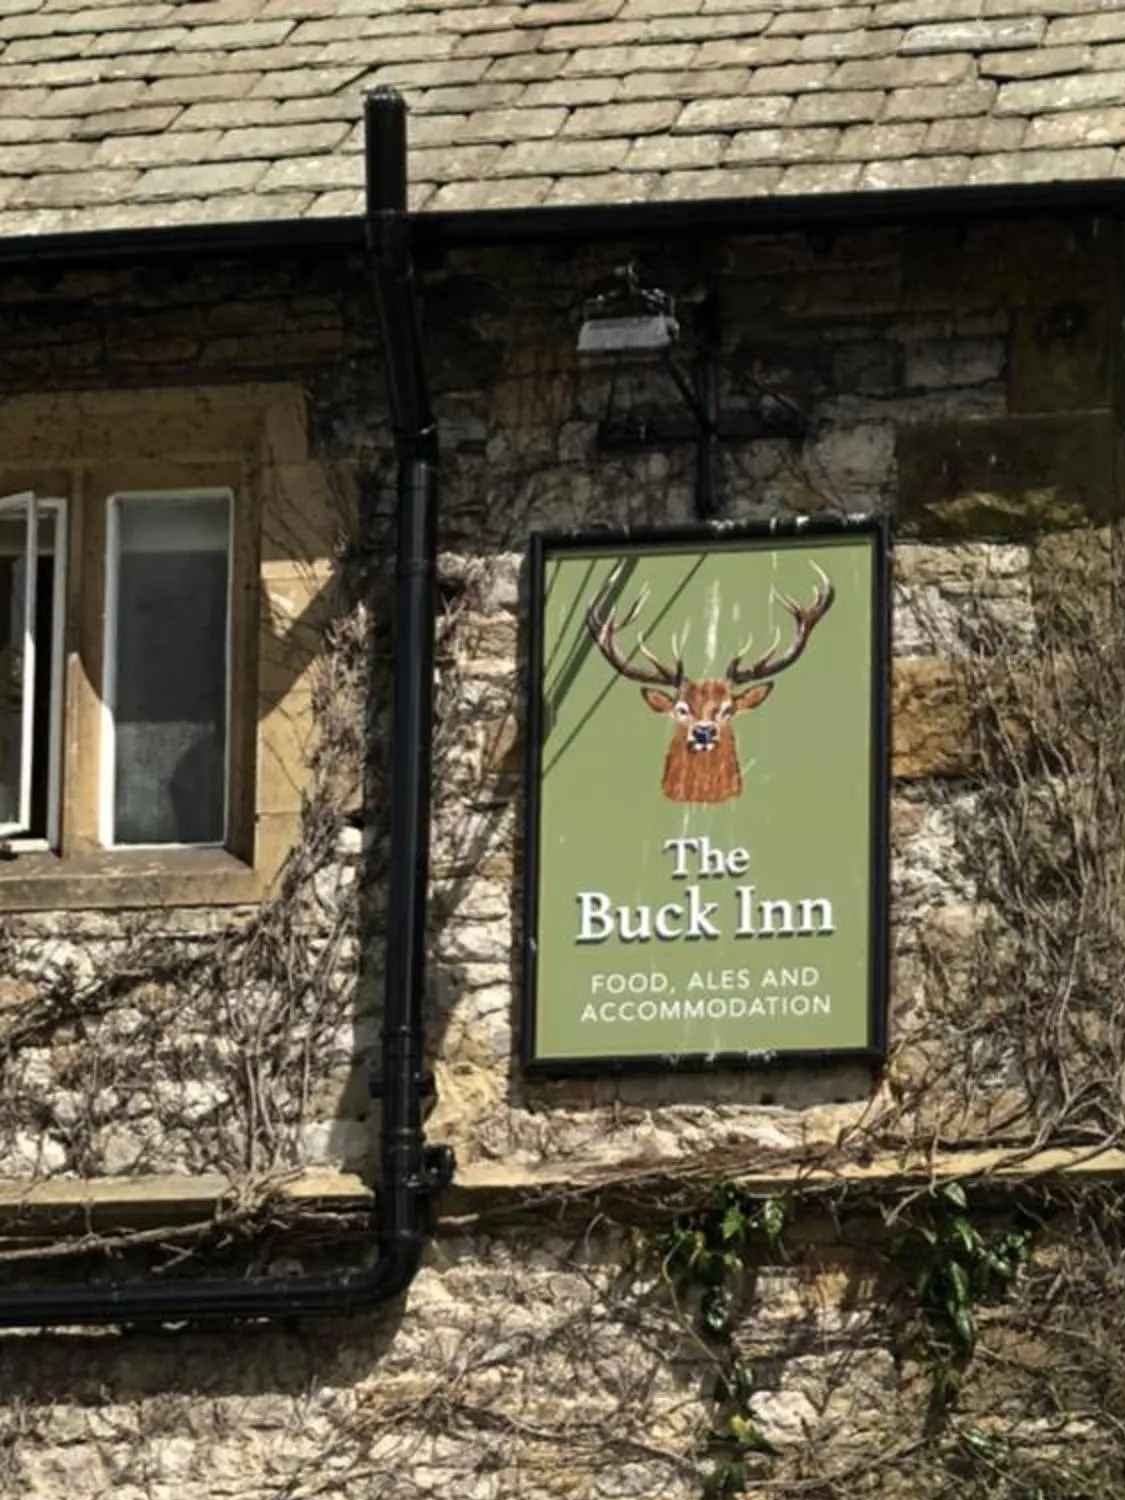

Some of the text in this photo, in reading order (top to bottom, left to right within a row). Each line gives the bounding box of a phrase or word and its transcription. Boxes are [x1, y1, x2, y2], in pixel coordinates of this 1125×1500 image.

[662, 836, 750, 879] The
[575, 884, 837, 945] Buck Inn
[591, 966, 820, 995] FOOD, ALES AND
[580, 994, 832, 1023] ACCOMMODATION
